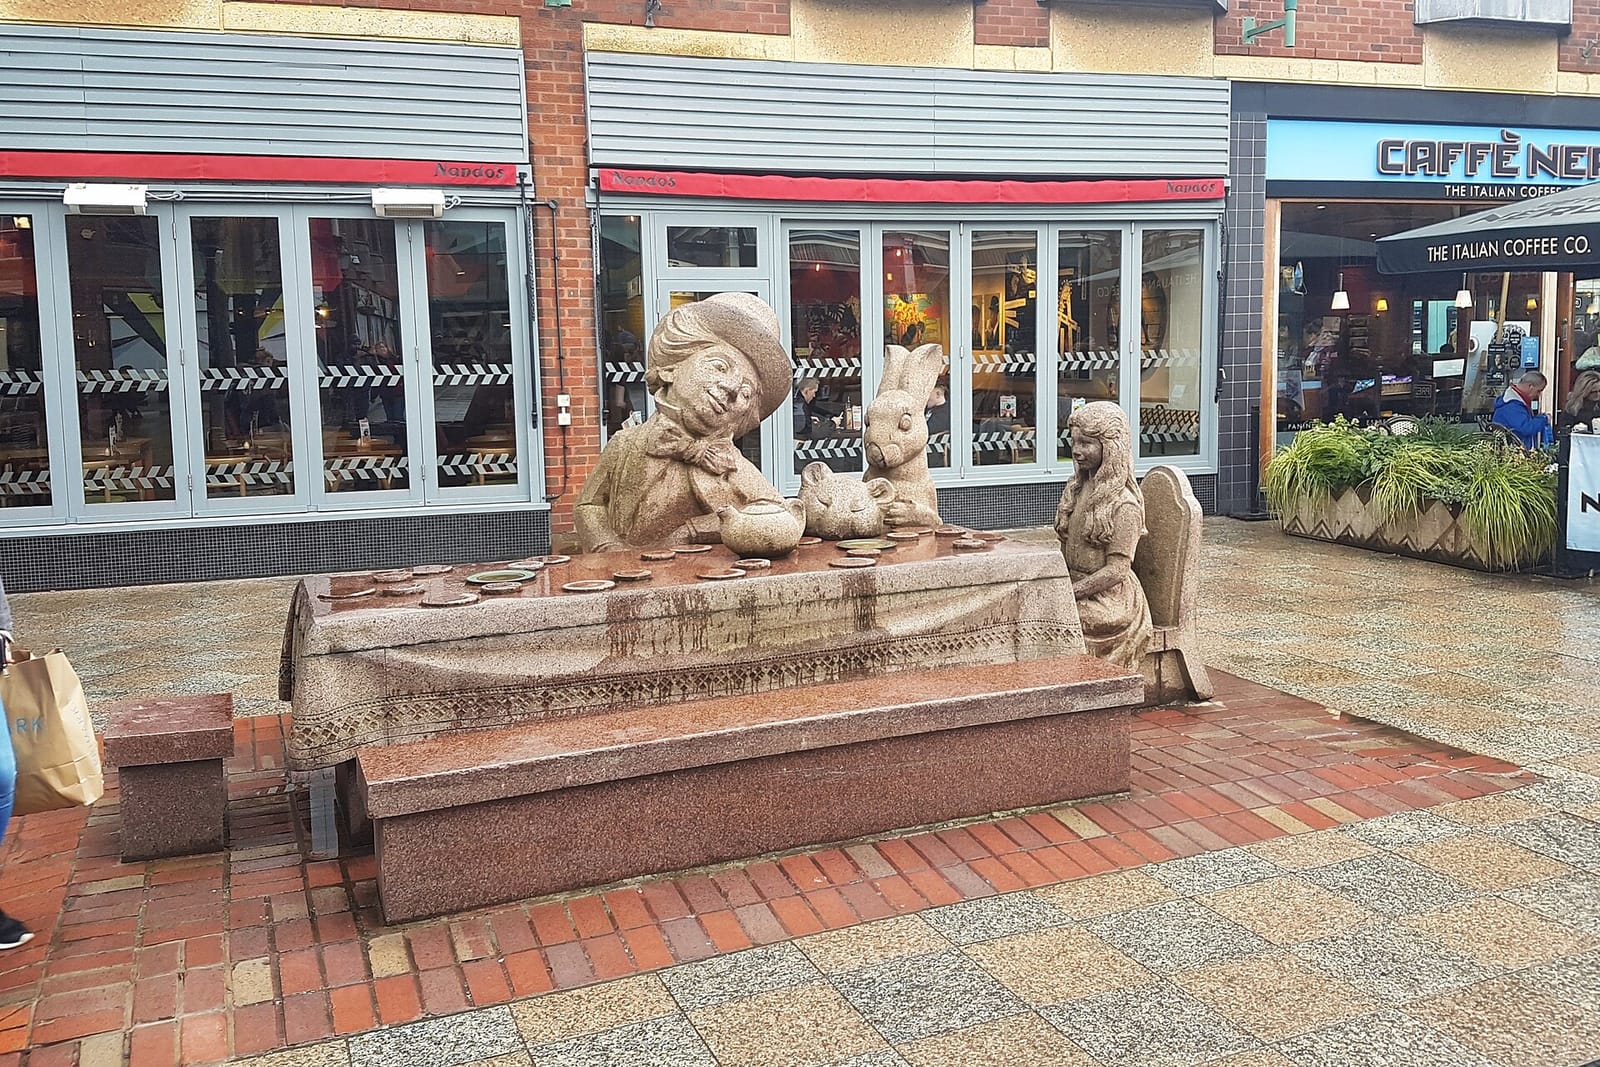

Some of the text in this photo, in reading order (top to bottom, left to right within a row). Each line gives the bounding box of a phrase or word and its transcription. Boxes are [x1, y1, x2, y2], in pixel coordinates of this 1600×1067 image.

[1377, 128, 1521, 177] CAFFÈ
[1444, 184, 1467, 197] THE
[1470, 185, 1516, 198] ITALIAN
[1427, 235, 1592, 262] THE ITALIAN COFFEE CO.
